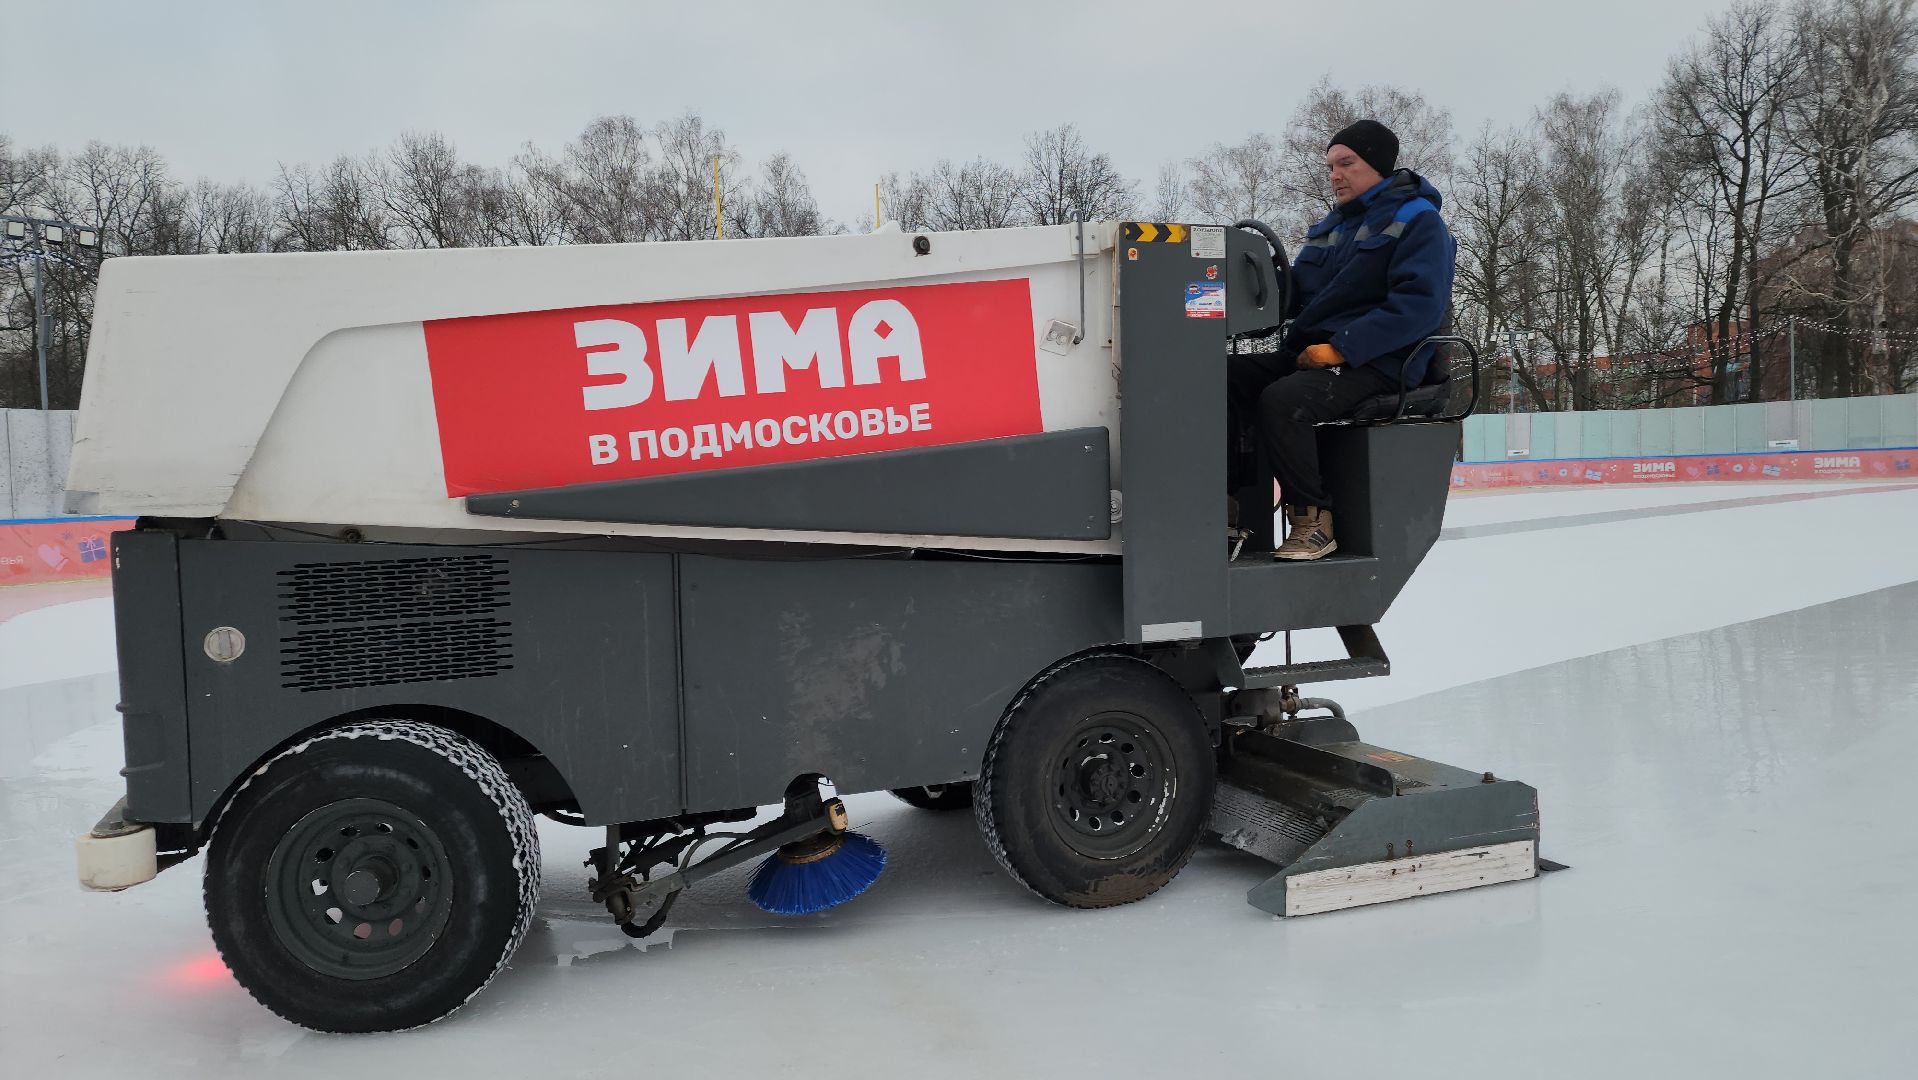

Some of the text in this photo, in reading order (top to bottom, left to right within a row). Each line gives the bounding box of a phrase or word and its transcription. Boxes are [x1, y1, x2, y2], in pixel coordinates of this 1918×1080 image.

[573, 299, 927, 411] ЗИМА
[588, 402, 932, 466] В ПОДМОСКОВЬЕ
[1633, 461, 1675, 473] ЗИМА
[1814, 456, 1860, 469] ЗИМА
